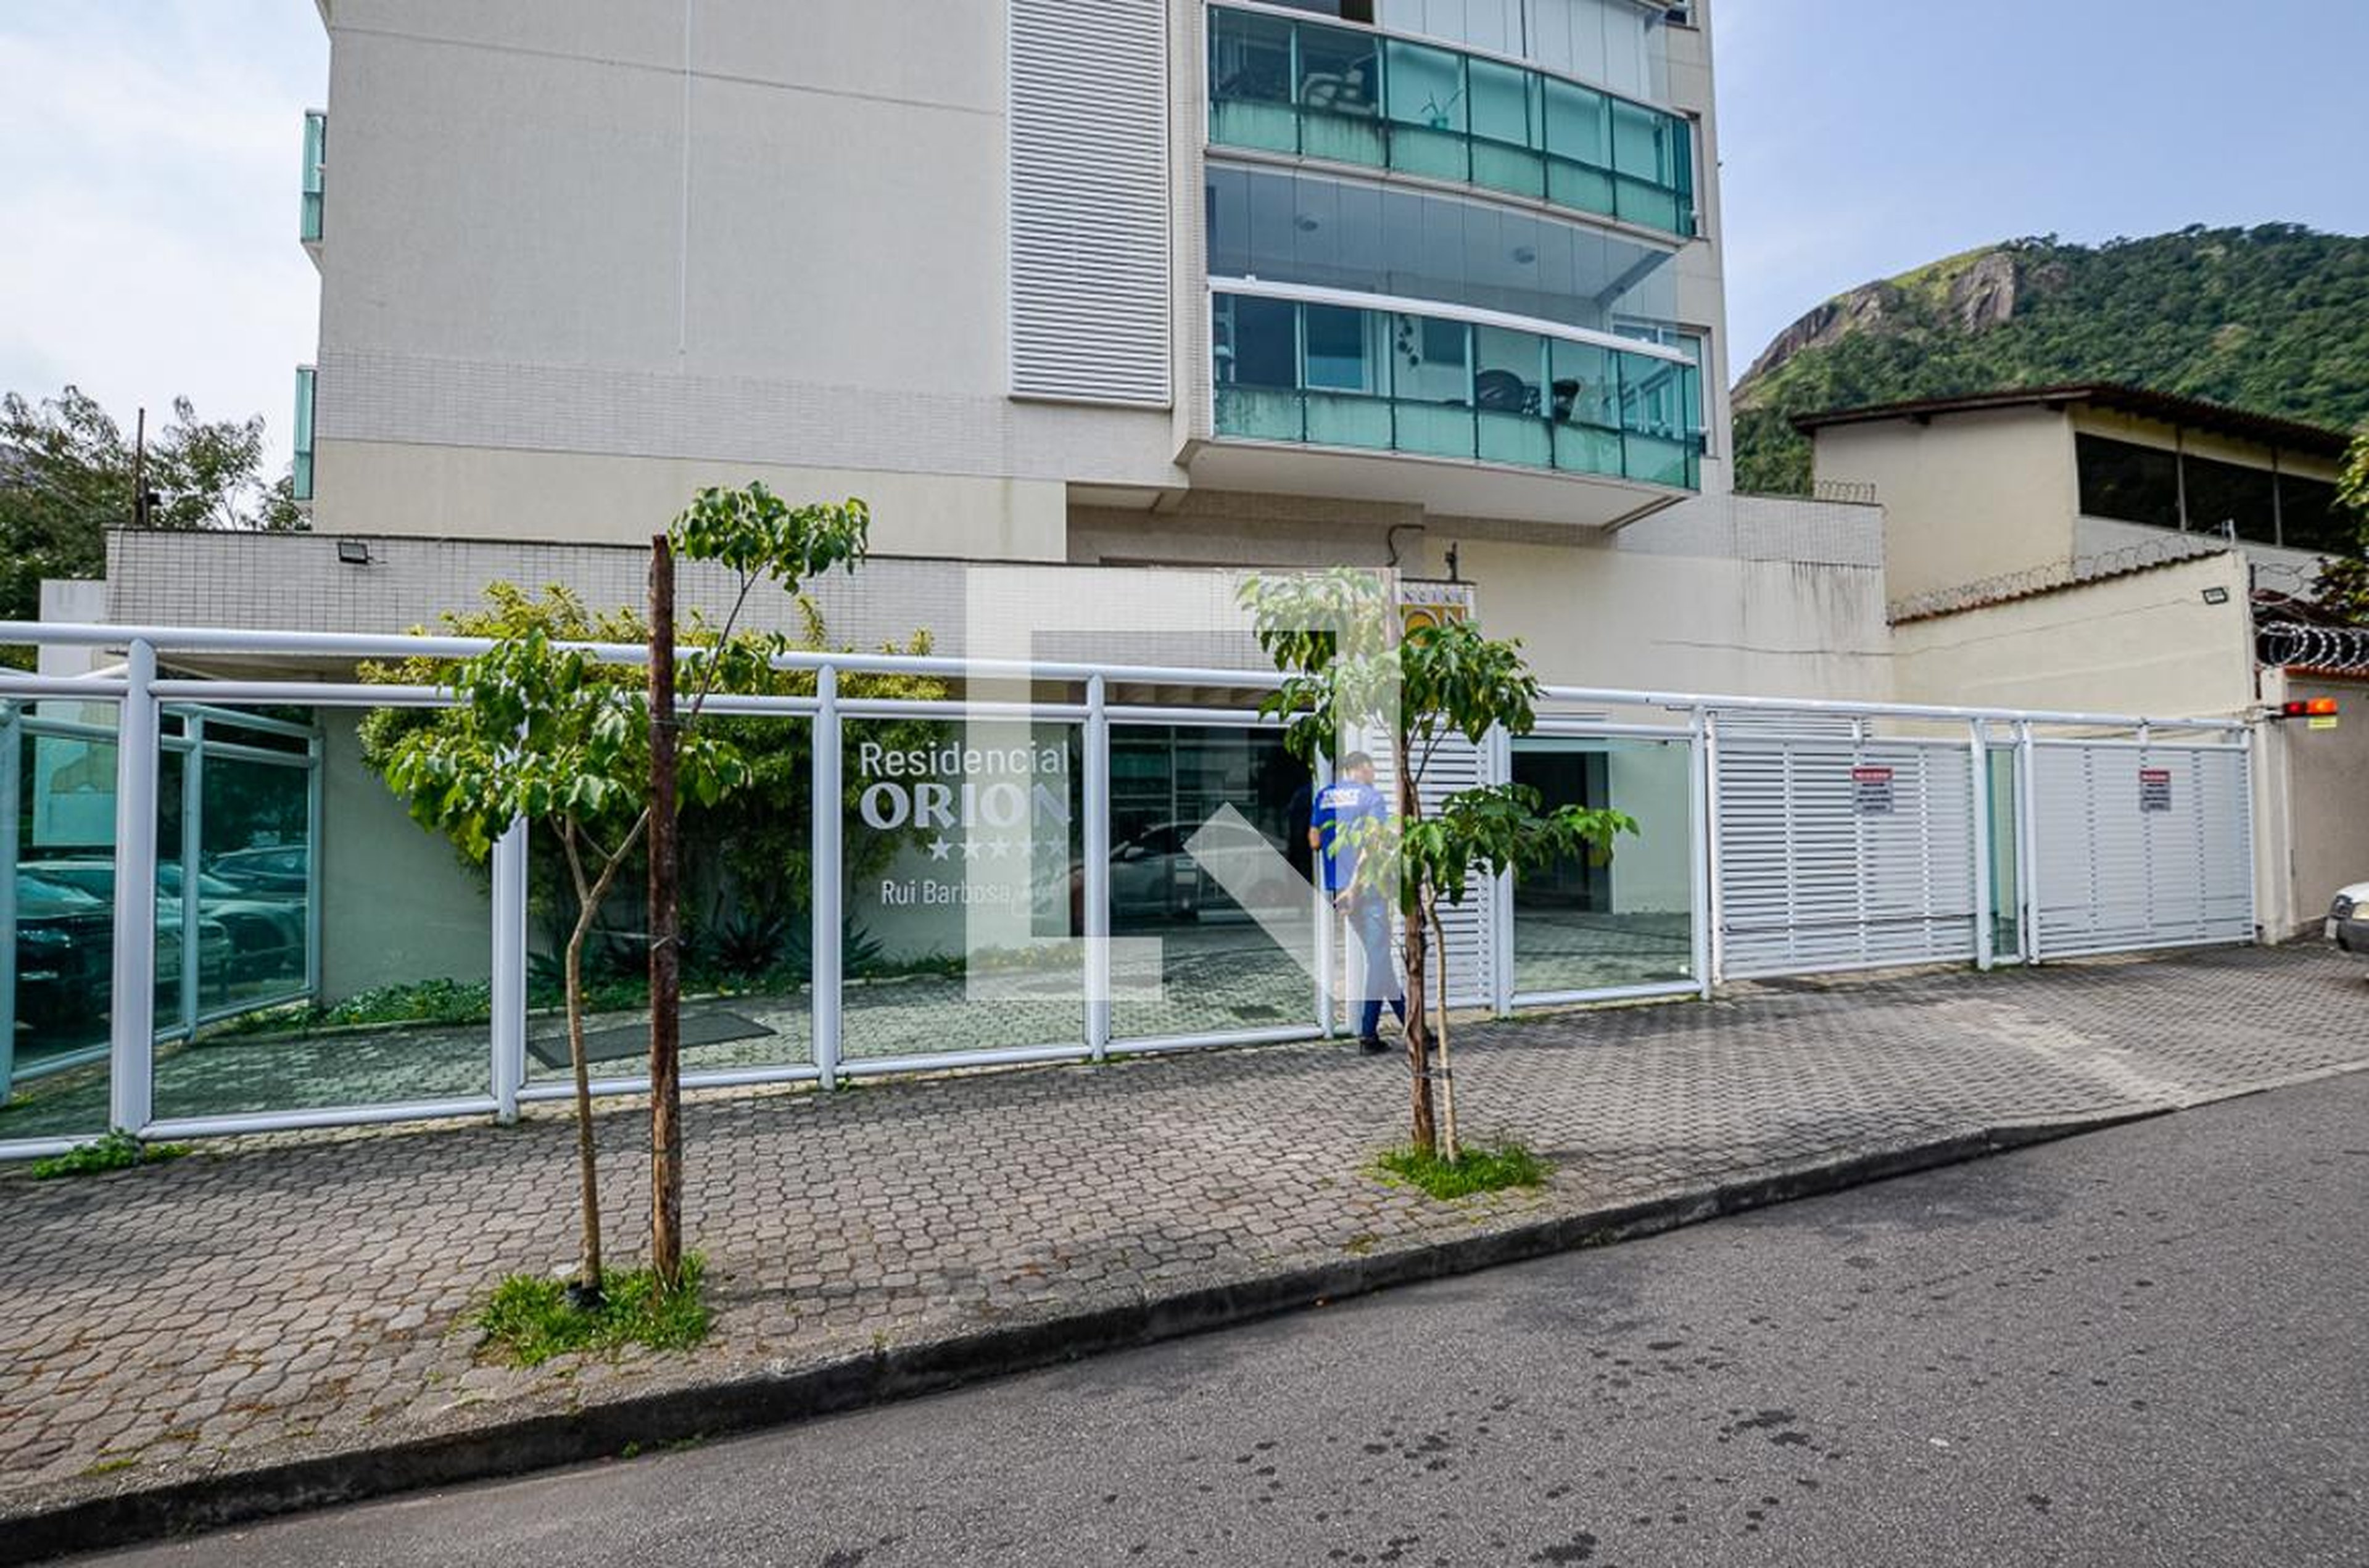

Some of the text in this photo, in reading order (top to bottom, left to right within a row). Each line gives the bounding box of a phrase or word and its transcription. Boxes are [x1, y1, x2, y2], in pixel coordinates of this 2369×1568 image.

[859, 741, 1069, 777] Residencial
[860, 782, 1072, 830] ORION
[882, 880, 916, 904] Rui
